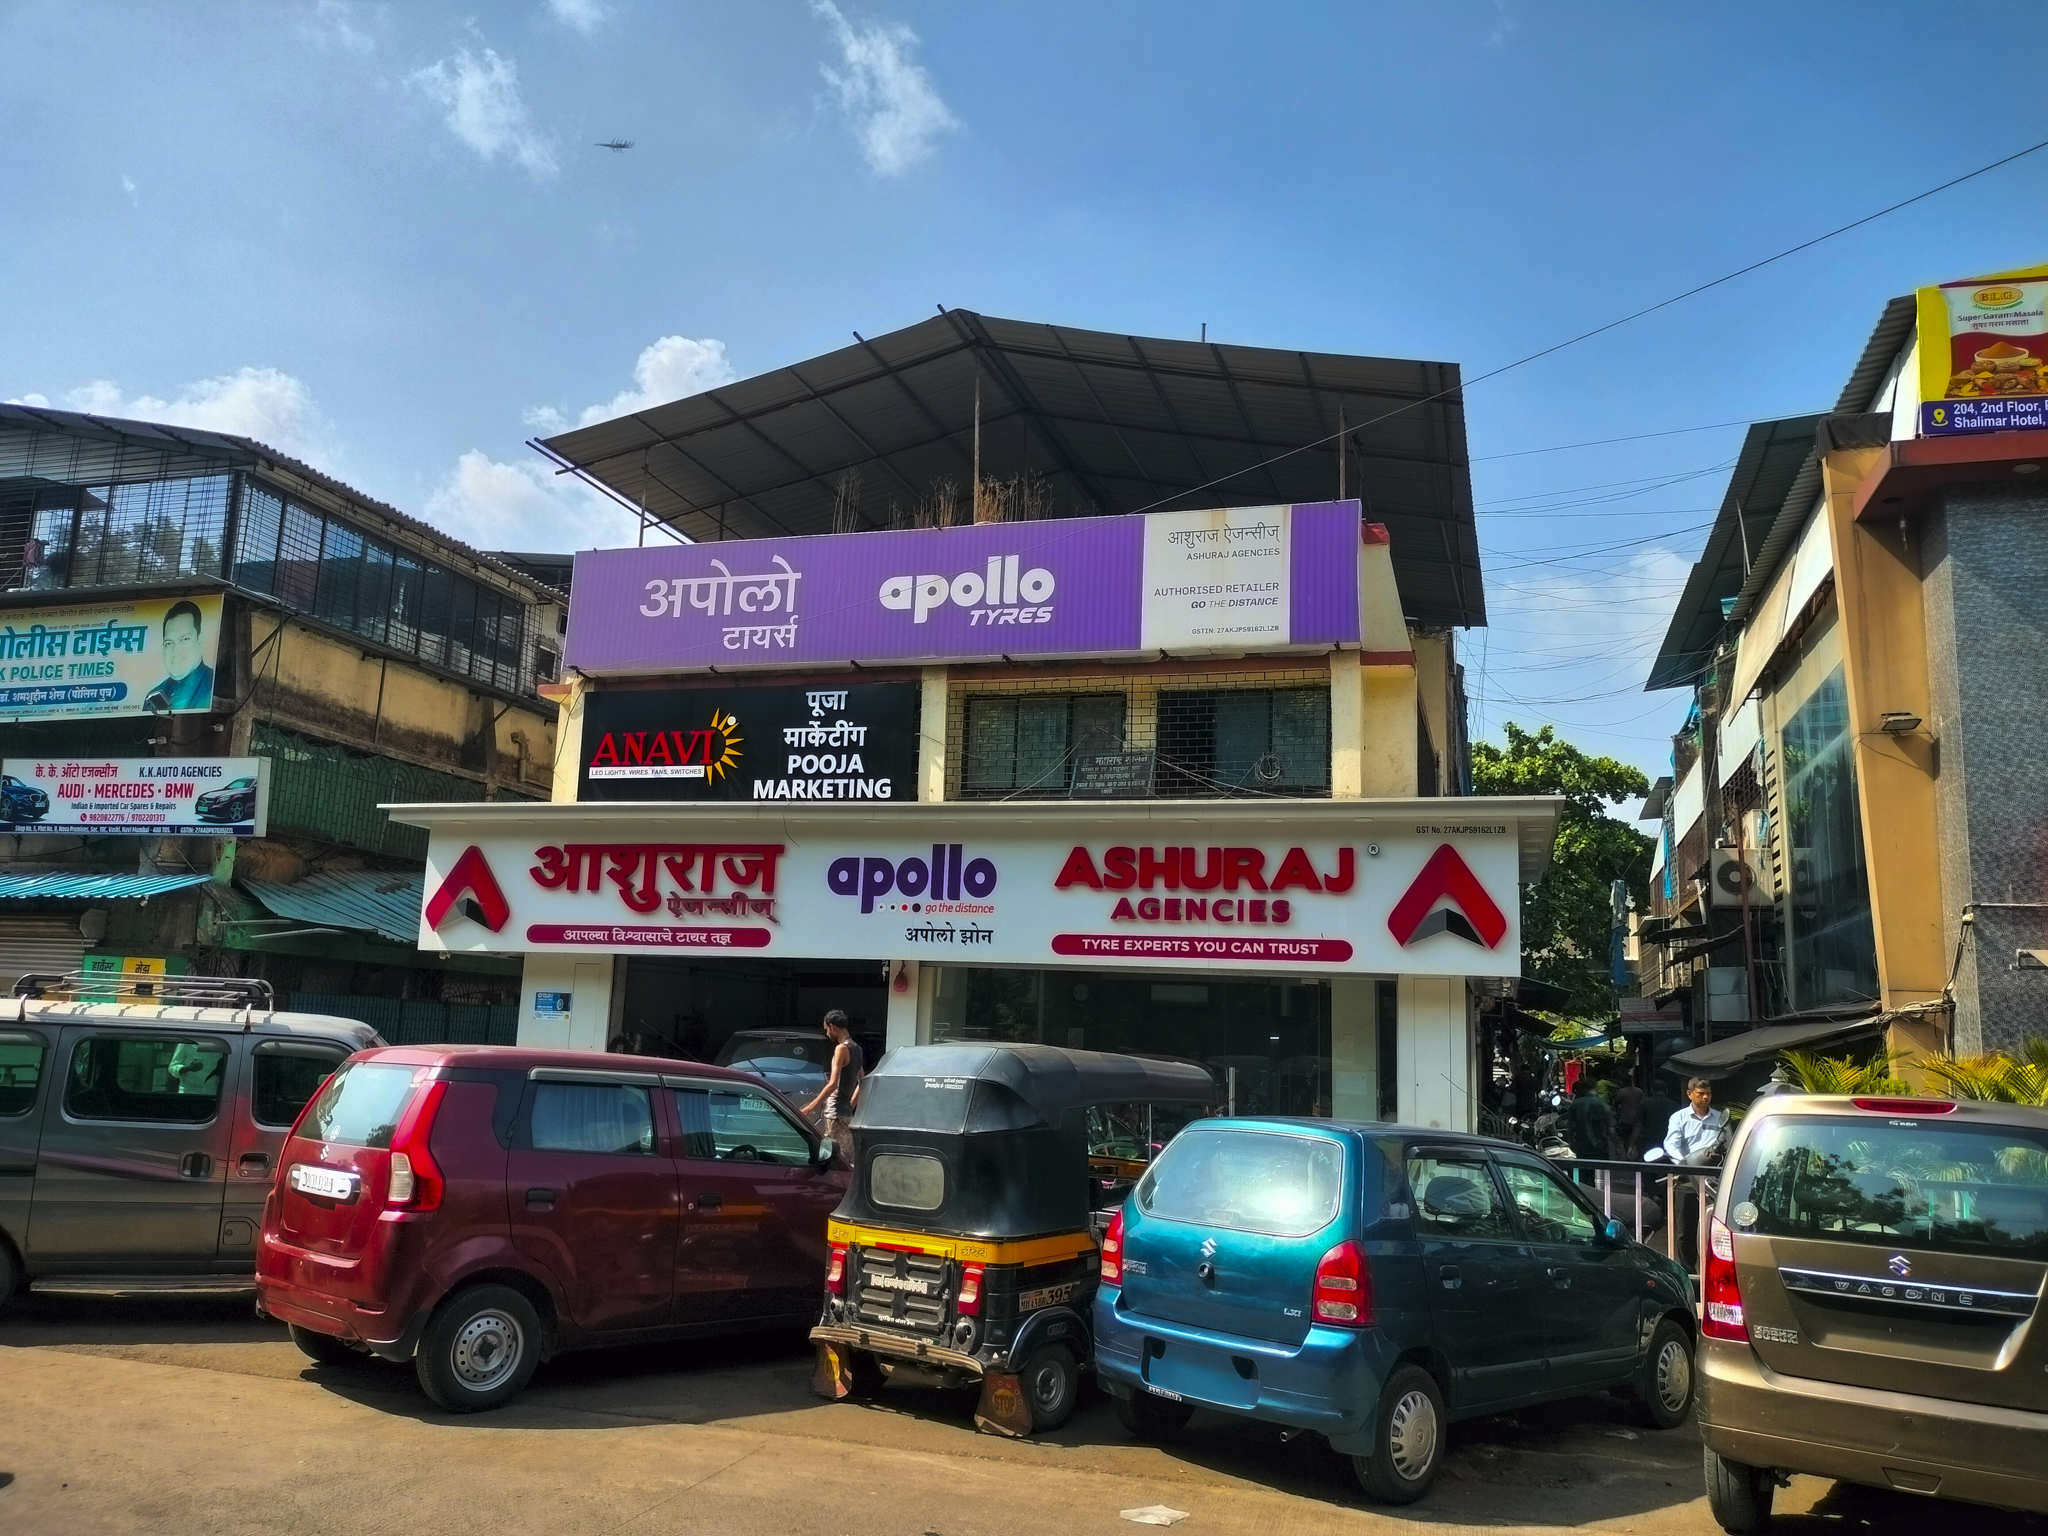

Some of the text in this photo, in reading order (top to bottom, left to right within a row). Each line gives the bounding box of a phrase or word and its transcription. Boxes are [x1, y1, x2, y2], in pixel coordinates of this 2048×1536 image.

[1983, 311, 2011, 319] Garam
[2014, 310, 2044, 318] Masala
[1953, 403, 1978, 416] 204,
[1981, 402, 2004, 414] 2nd
[2006, 401, 2041, 414] Floor,
[1954, 414, 2046, 428] Shalimar Hotel,
[1167, 529, 1220, 549] आशुराज
[1186, 548, 1280, 561] ASHURAJ AGENCIES
[639, 554, 802, 618] अपोलो
[879, 554, 1055, 624] apollo
[1154, 582, 1279, 597] AUTHORISED RETAILER
[1191, 597, 1279, 609] GO THE DISTANCE
[970, 606, 1054, 626] TYRES
[72, 619, 148, 656] टाईम्स
[722, 614, 799, 650] टायर्स
[10, 664, 64, 680] POLICE
[68, 661, 114, 678] TIMES
[49, 688, 65, 700] शेख
[806, 691, 848, 717] पूजा
[590, 730, 715, 766] ANAVI
[36, 763, 118, 778] के. के. ऑटो एजन्सीज
[181, 766, 222, 777] AGENCIES
[787, 754, 865, 775] POOJA
[57, 783, 194, 798] AUDI MERCEDES BMW
[753, 778, 892, 799] MARKETING
[94, 802, 119, 811] Imported
[130, 803, 149, 811] Spares
[156, 802, 176, 811] Repairs
[1416, 826, 1430, 834] GST
[1431, 826, 1442, 834] No.
[529, 844, 785, 913] आशुराज
[827, 843, 997, 914] apollo
[1054, 846, 1354, 892] ASHURAJ
[925, 903, 995, 914] go the distance
[1110, 897, 1291, 923] AGENCIES
[563, 927, 731, 944] आपल्या विश्वासाचे टायर तज्ञ
[905, 921, 994, 945] अपोलो झोन
[1082, 938, 1319, 955] TYRE EXPERTS YOU CAN TRUST
[994, 1394, 1016, 1414] STOP
